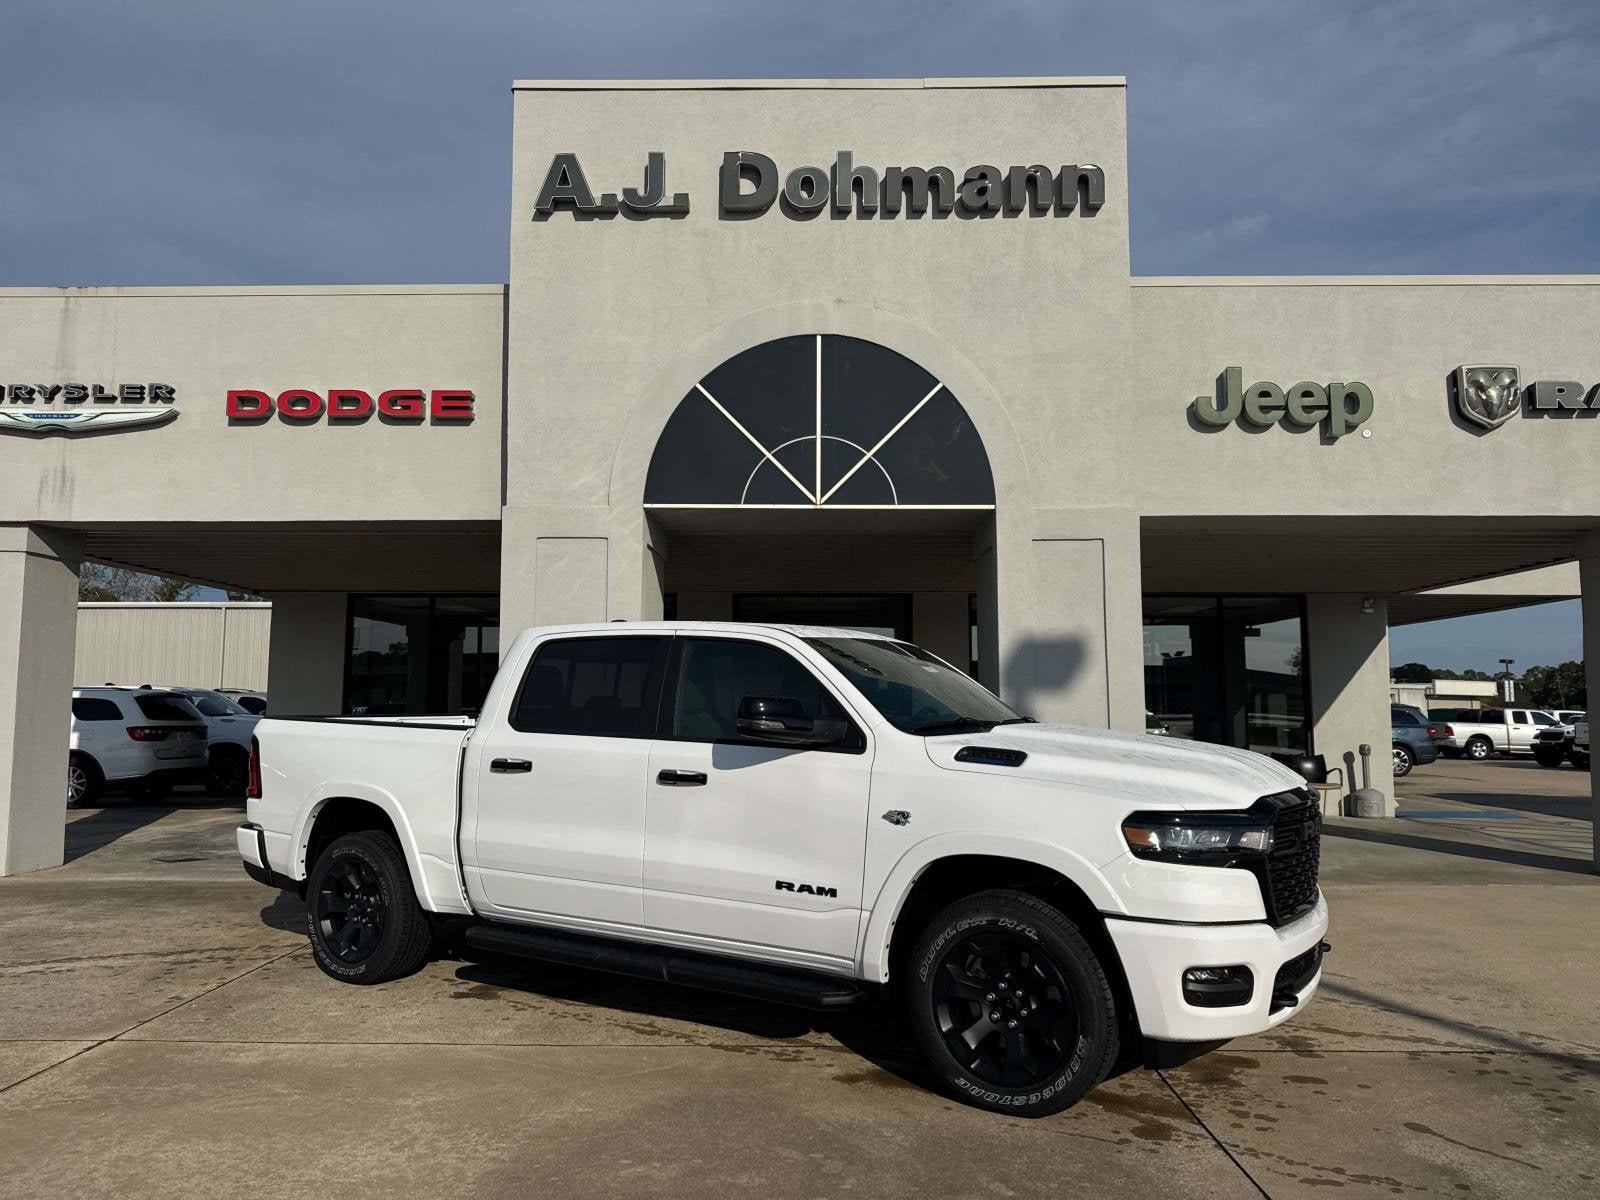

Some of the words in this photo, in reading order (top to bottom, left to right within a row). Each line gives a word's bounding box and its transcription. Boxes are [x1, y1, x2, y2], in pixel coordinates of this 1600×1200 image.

[531, 151, 690, 215] A.J.
[719, 150, 1105, 216] Dohmann
[0, 383, 176, 404] RYSLER
[227, 389, 475, 425] DODGE
[1190, 366, 1375, 441] Jeep
[1524, 380, 1600, 416] R
[775, 880, 837, 898] RAM
[919, 916, 989, 982] DUELER
[955, 1034, 1090, 1106] BRIDGESTONE
